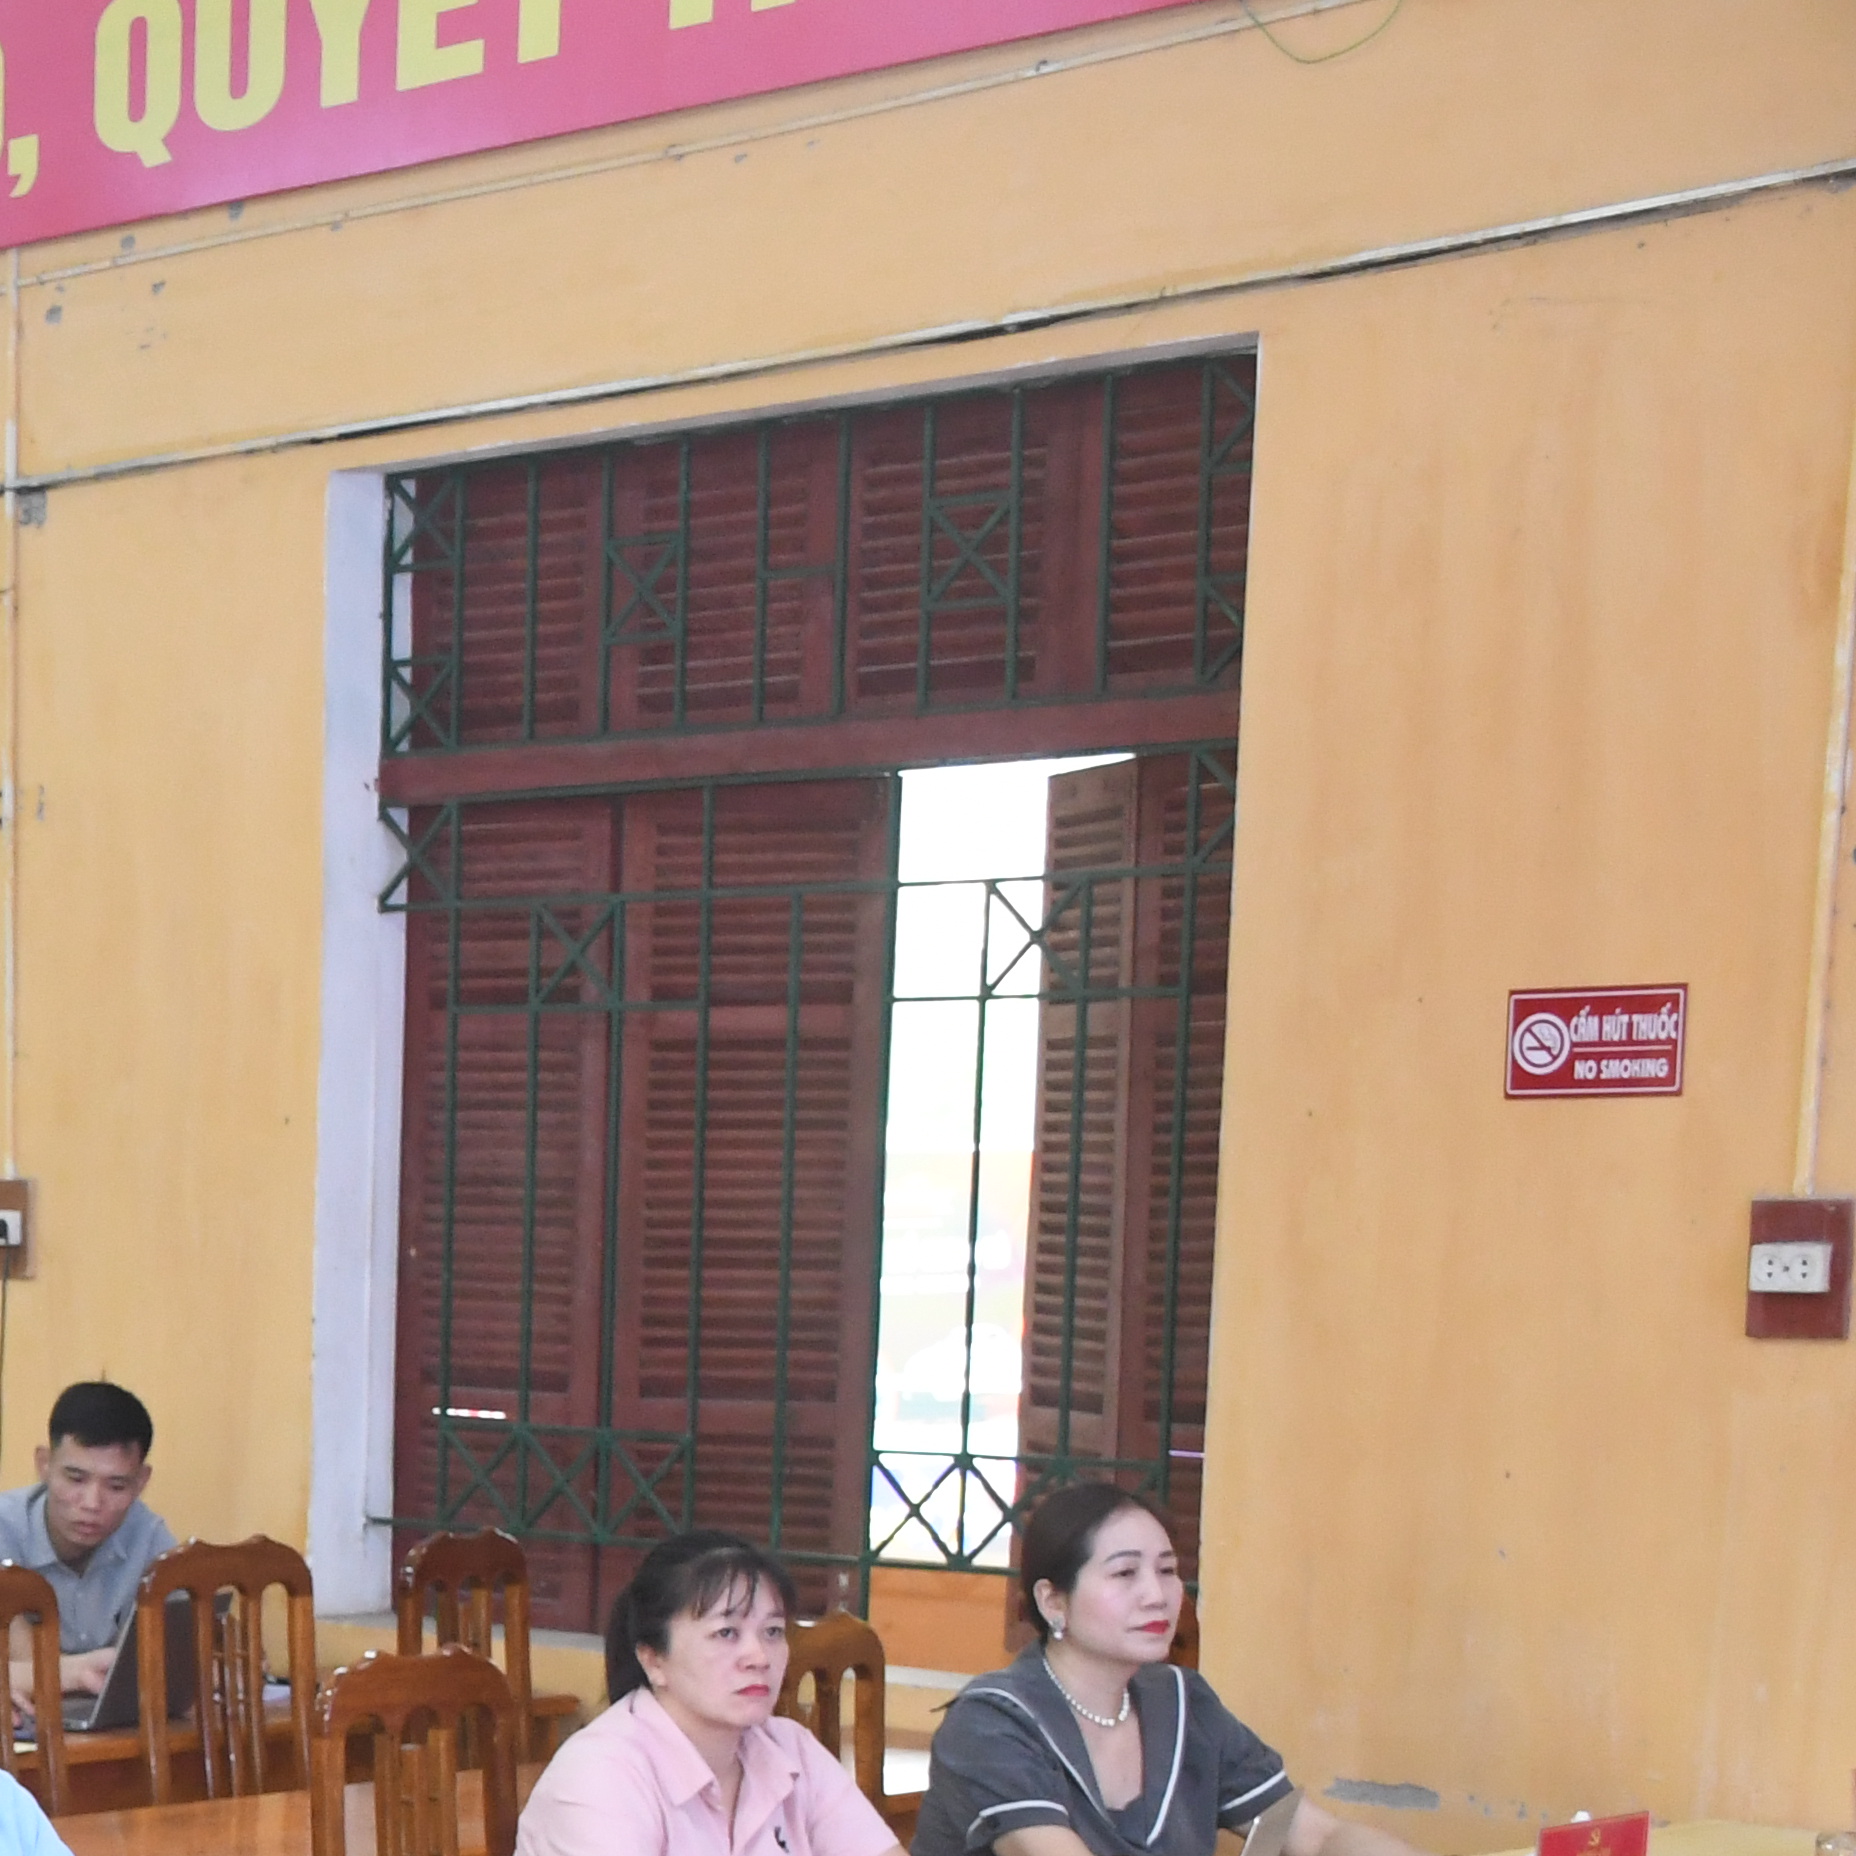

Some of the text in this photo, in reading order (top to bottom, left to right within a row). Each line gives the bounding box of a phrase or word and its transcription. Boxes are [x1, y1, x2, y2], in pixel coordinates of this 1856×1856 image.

[1570, 1001, 1679, 1042] CẤM HÚT THUỐC
[1573, 1057, 1669, 1080] NO SMOKING
